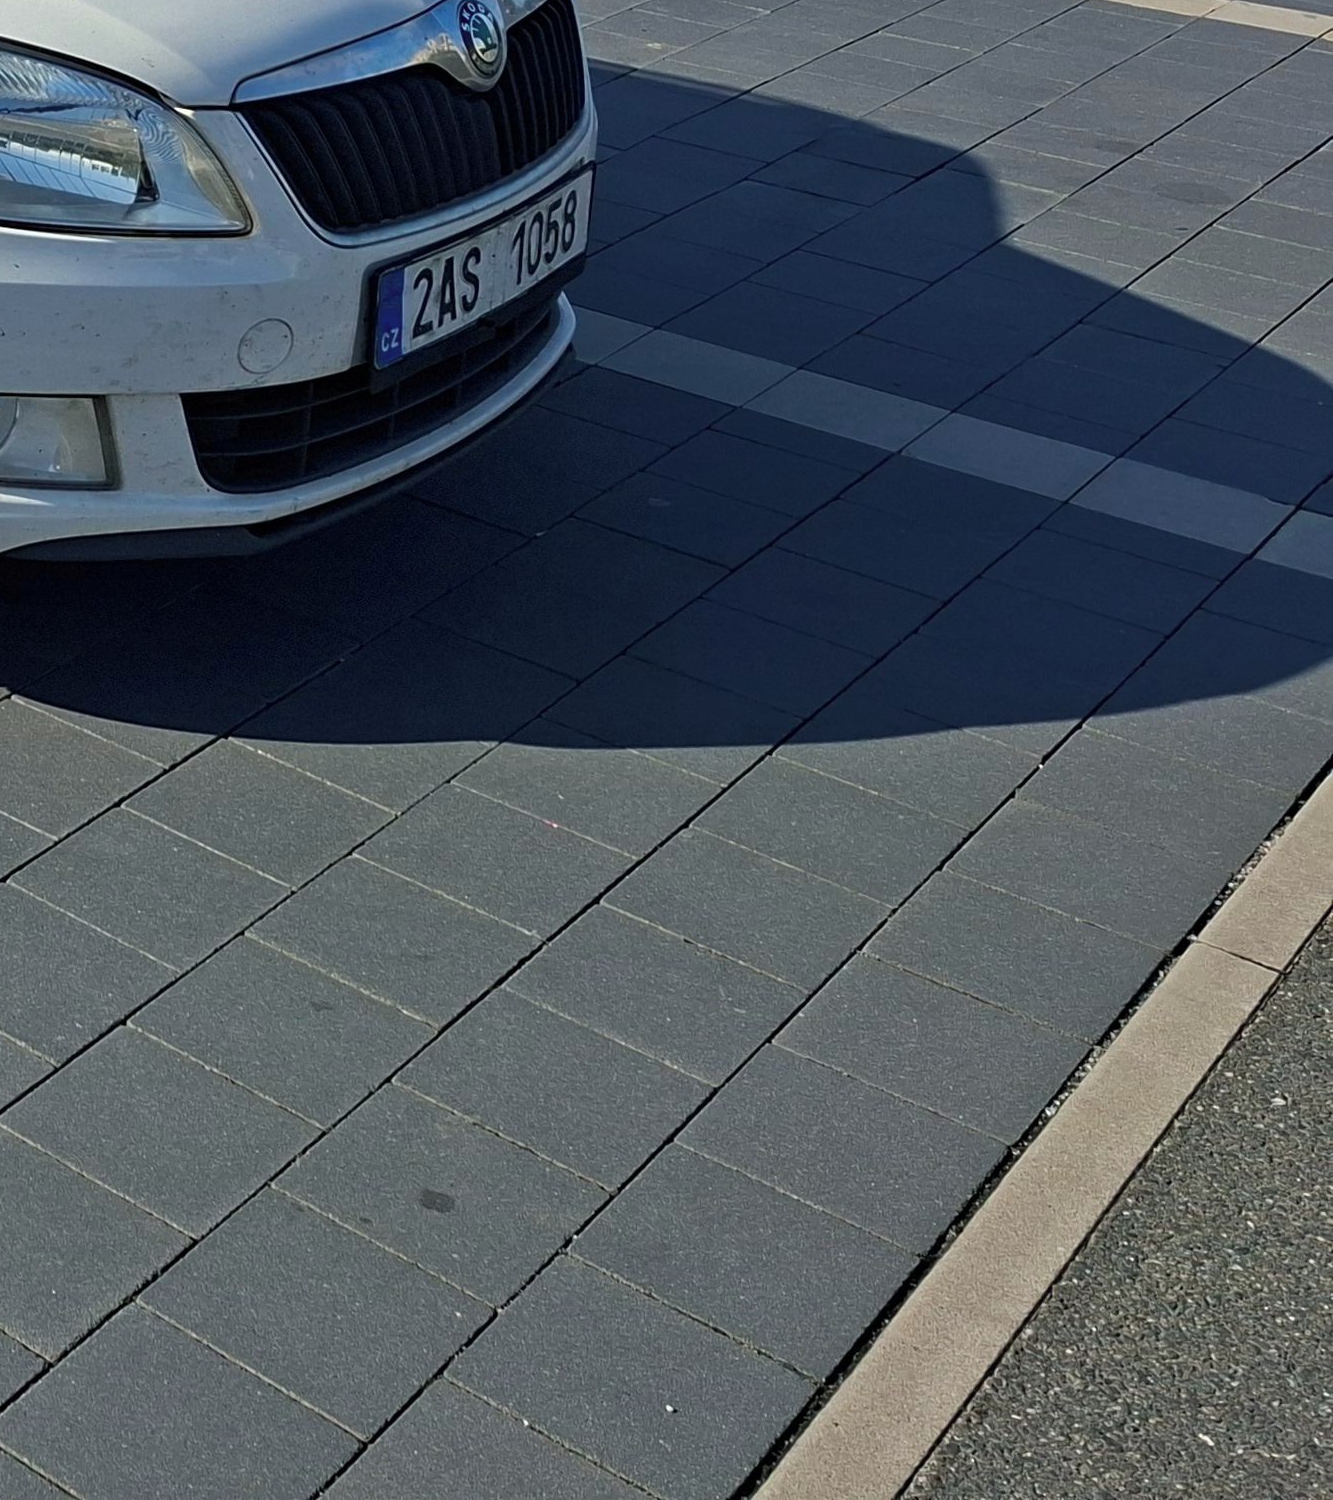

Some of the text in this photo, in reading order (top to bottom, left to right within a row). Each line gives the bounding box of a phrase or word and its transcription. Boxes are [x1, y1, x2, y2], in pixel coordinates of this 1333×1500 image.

[412, 190, 577, 339] 2AS 1058
[381, 327, 399, 352] CZ
